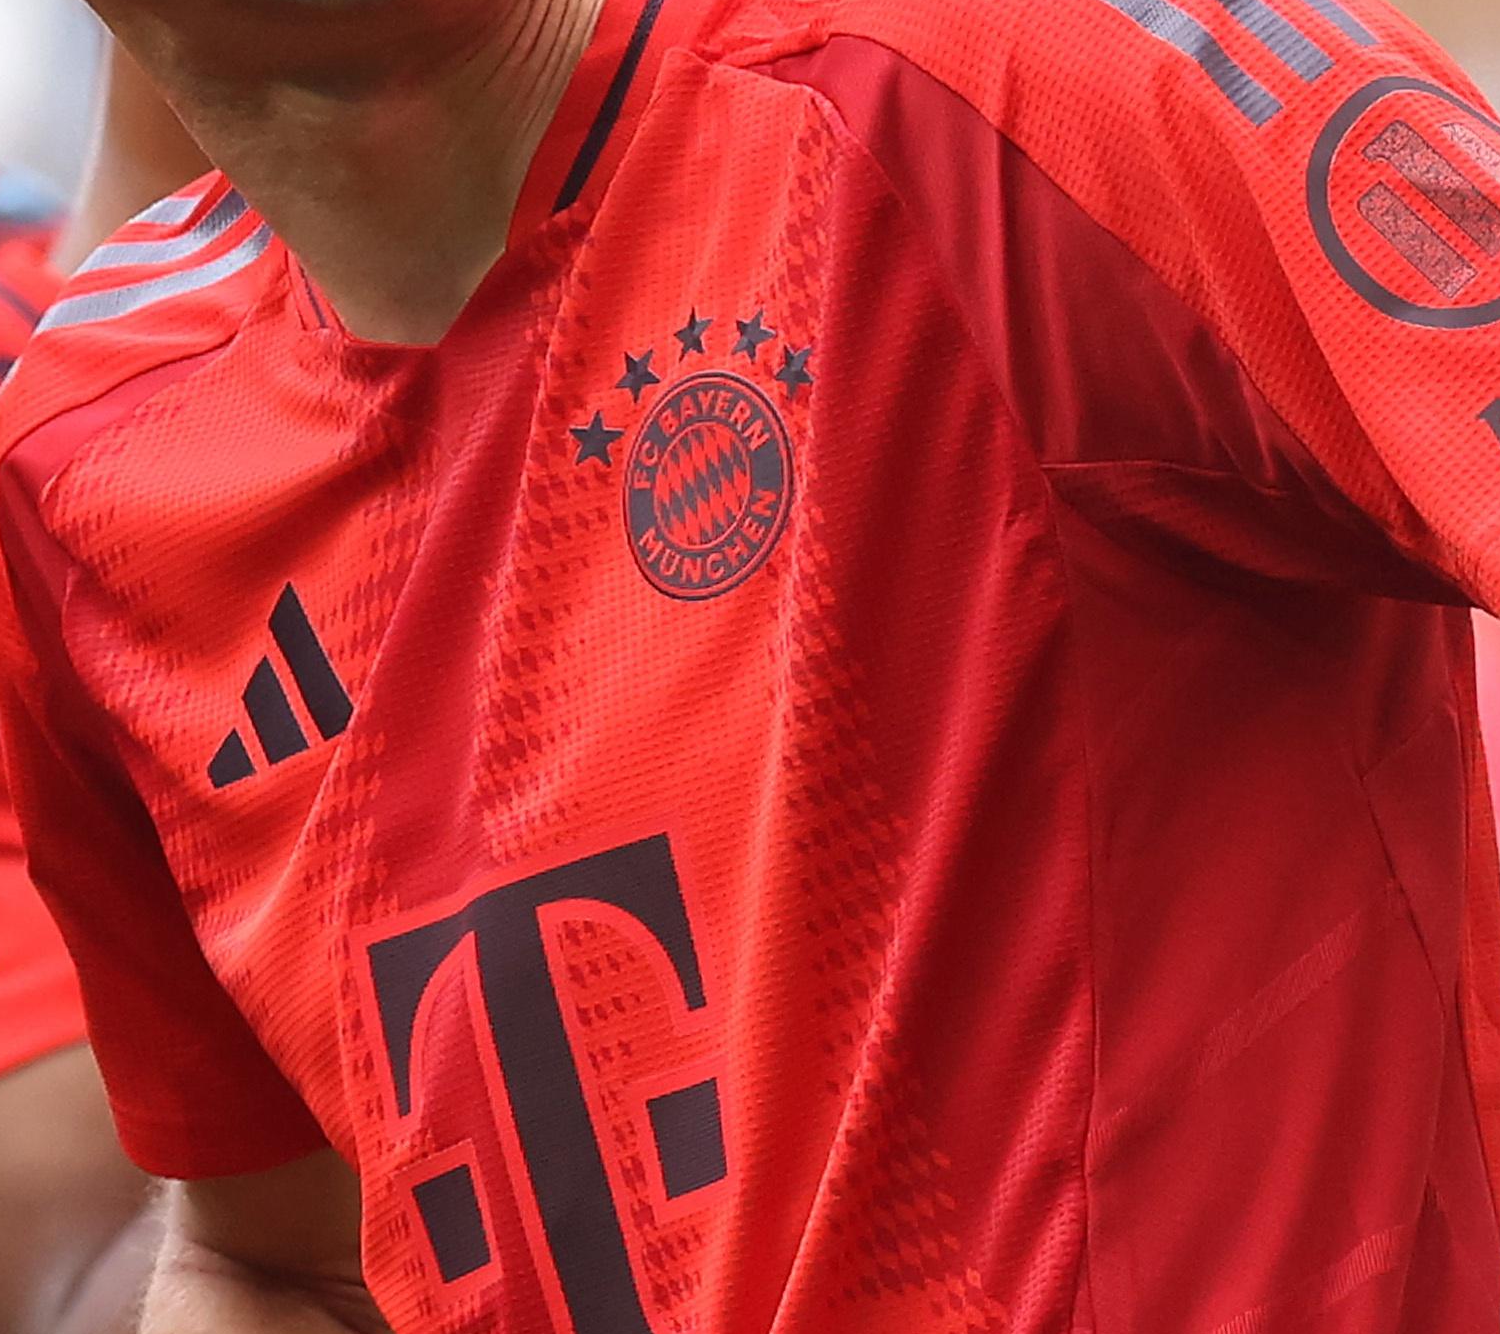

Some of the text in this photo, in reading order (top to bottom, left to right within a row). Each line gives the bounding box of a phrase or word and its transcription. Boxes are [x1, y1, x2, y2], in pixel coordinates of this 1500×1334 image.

[632, 389, 771, 491] FC BAYERN
[638, 489, 778, 585] MÜNCHEN
